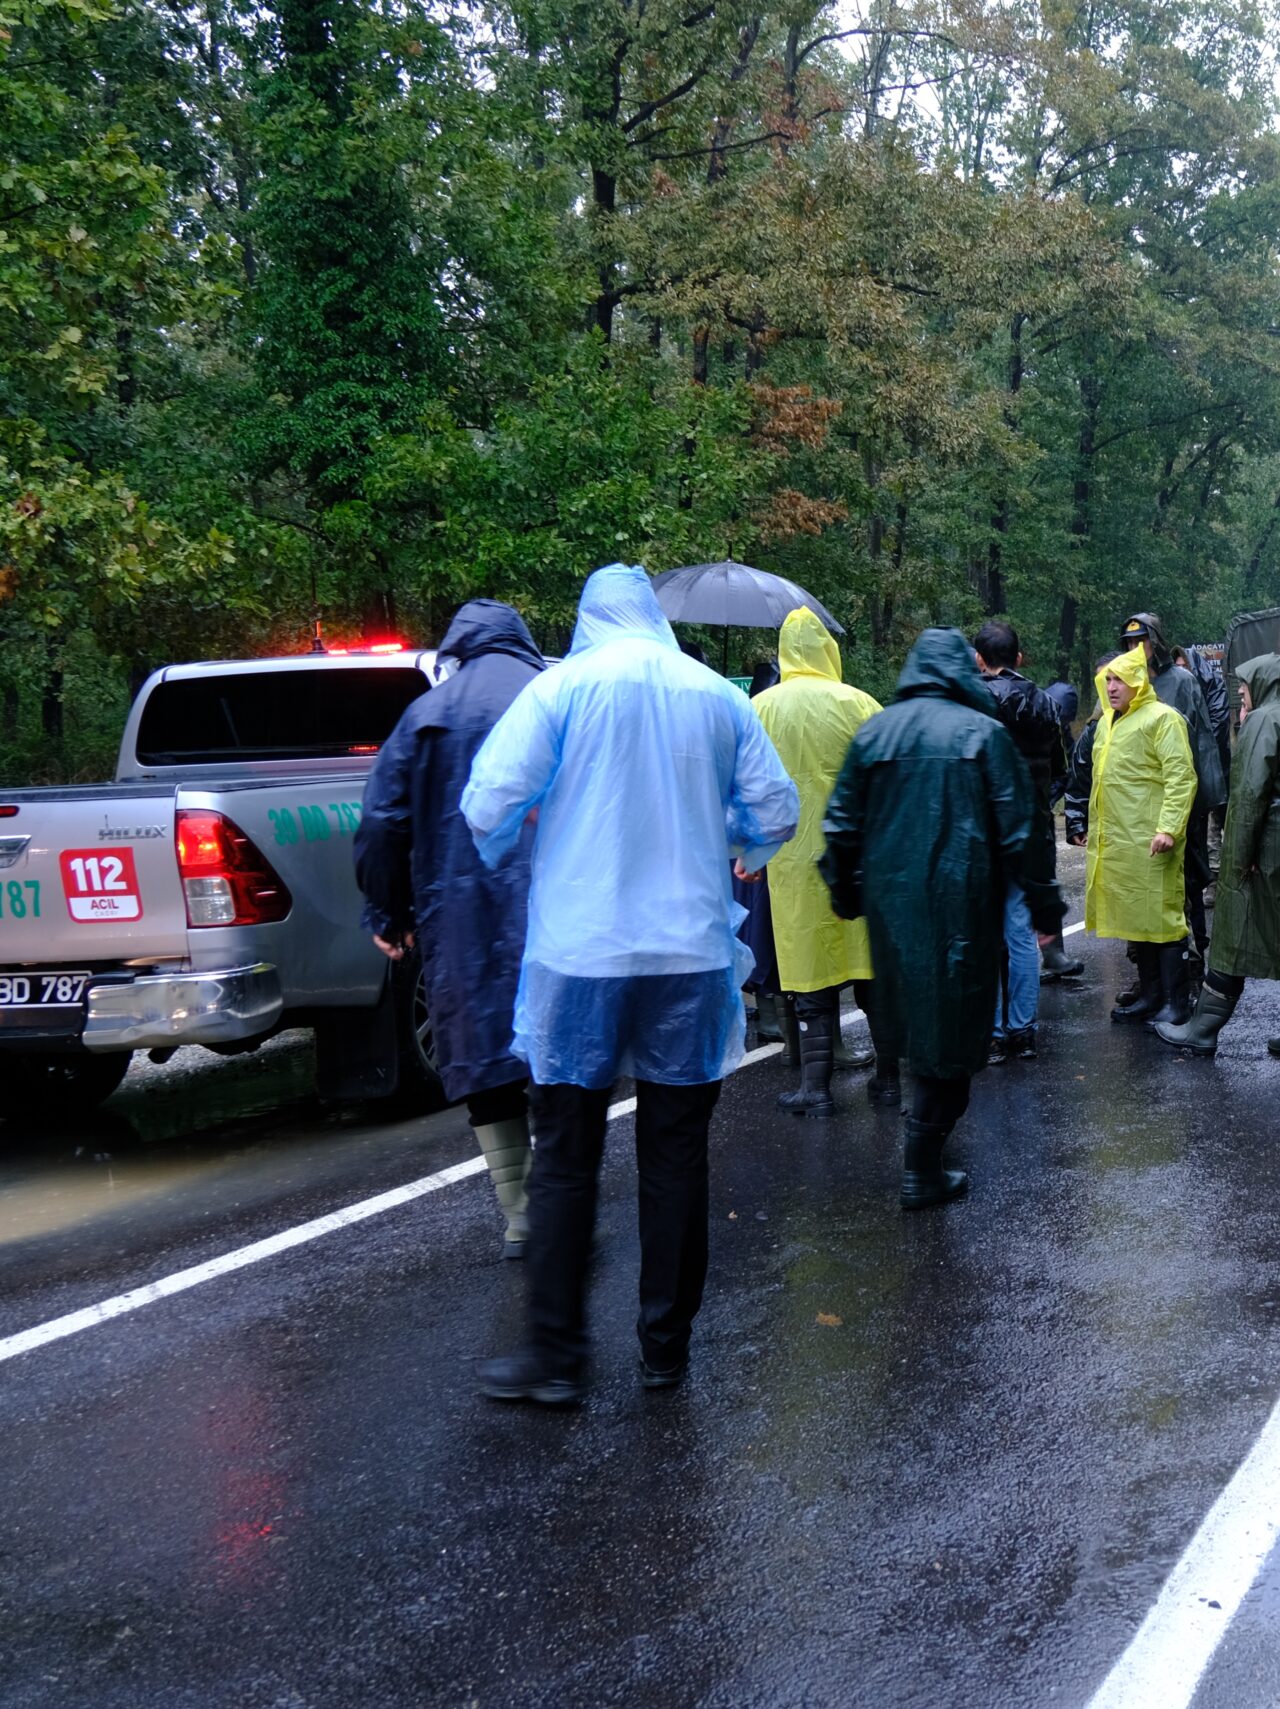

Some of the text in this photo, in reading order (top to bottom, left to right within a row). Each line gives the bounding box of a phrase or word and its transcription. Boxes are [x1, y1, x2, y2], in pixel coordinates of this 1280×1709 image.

[70, 856, 128, 891] 112
[0, 879, 41, 919] 87
[41, 976, 88, 1003] 787
